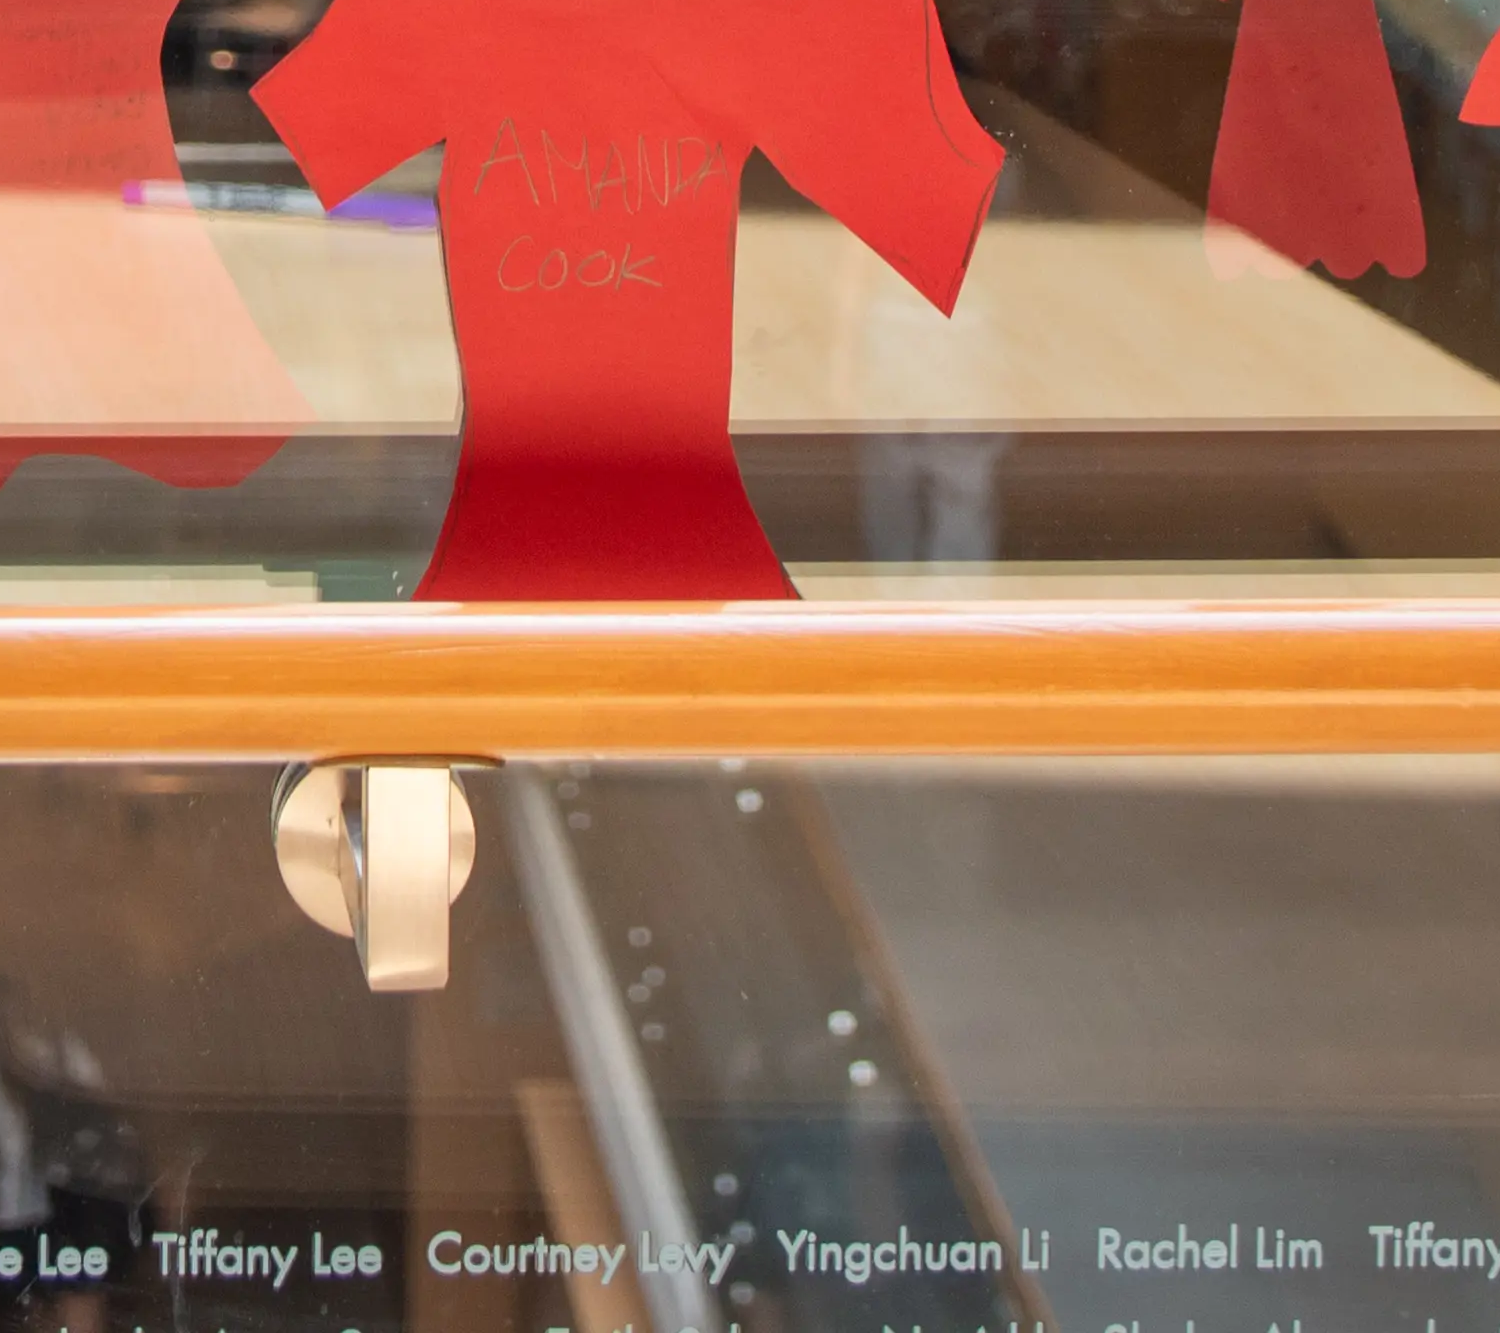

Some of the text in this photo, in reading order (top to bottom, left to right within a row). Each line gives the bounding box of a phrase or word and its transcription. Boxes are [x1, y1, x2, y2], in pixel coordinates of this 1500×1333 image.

[475, 116, 730, 214] AMANDA
[36, 1233, 109, 1278] Lee
[151, 1229, 298, 1290] Tiffany
[311, 1232, 383, 1276] Lee
[427, 1230, 626, 1285] Courtney
[637, 1230, 736, 1285] Levy
[776, 1226, 1002, 1284] Yingchuan
[1021, 1228, 1051, 1272] Li
[1097, 1224, 1239, 1271] Rachel
[1255, 1226, 1325, 1271] Lim
